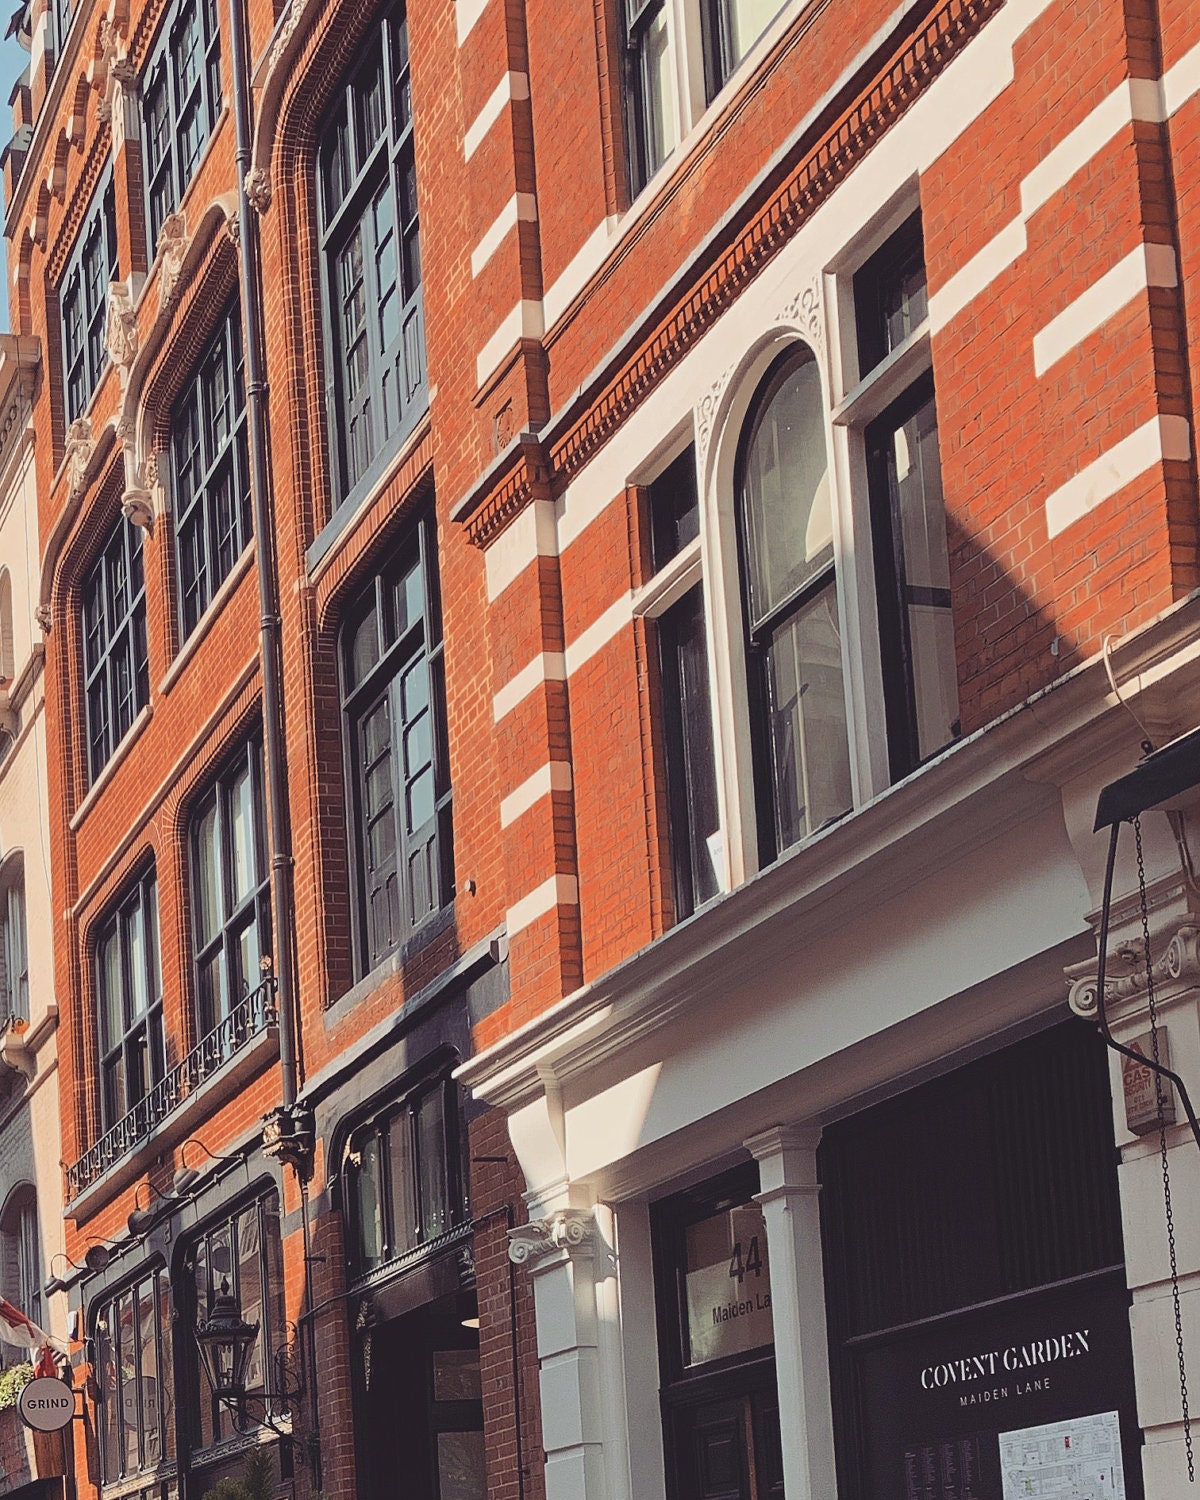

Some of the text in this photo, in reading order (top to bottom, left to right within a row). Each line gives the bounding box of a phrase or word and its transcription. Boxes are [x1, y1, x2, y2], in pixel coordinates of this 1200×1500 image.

[729, 1235, 763, 1284] 44
[712, 1293, 772, 1325] Maiden La
[921, 1329, 1090, 1390] COVENT GARDEN
[26, 1398, 69, 1409] GRIND
[960, 1377, 1051, 1407] MAIDEN LANE
